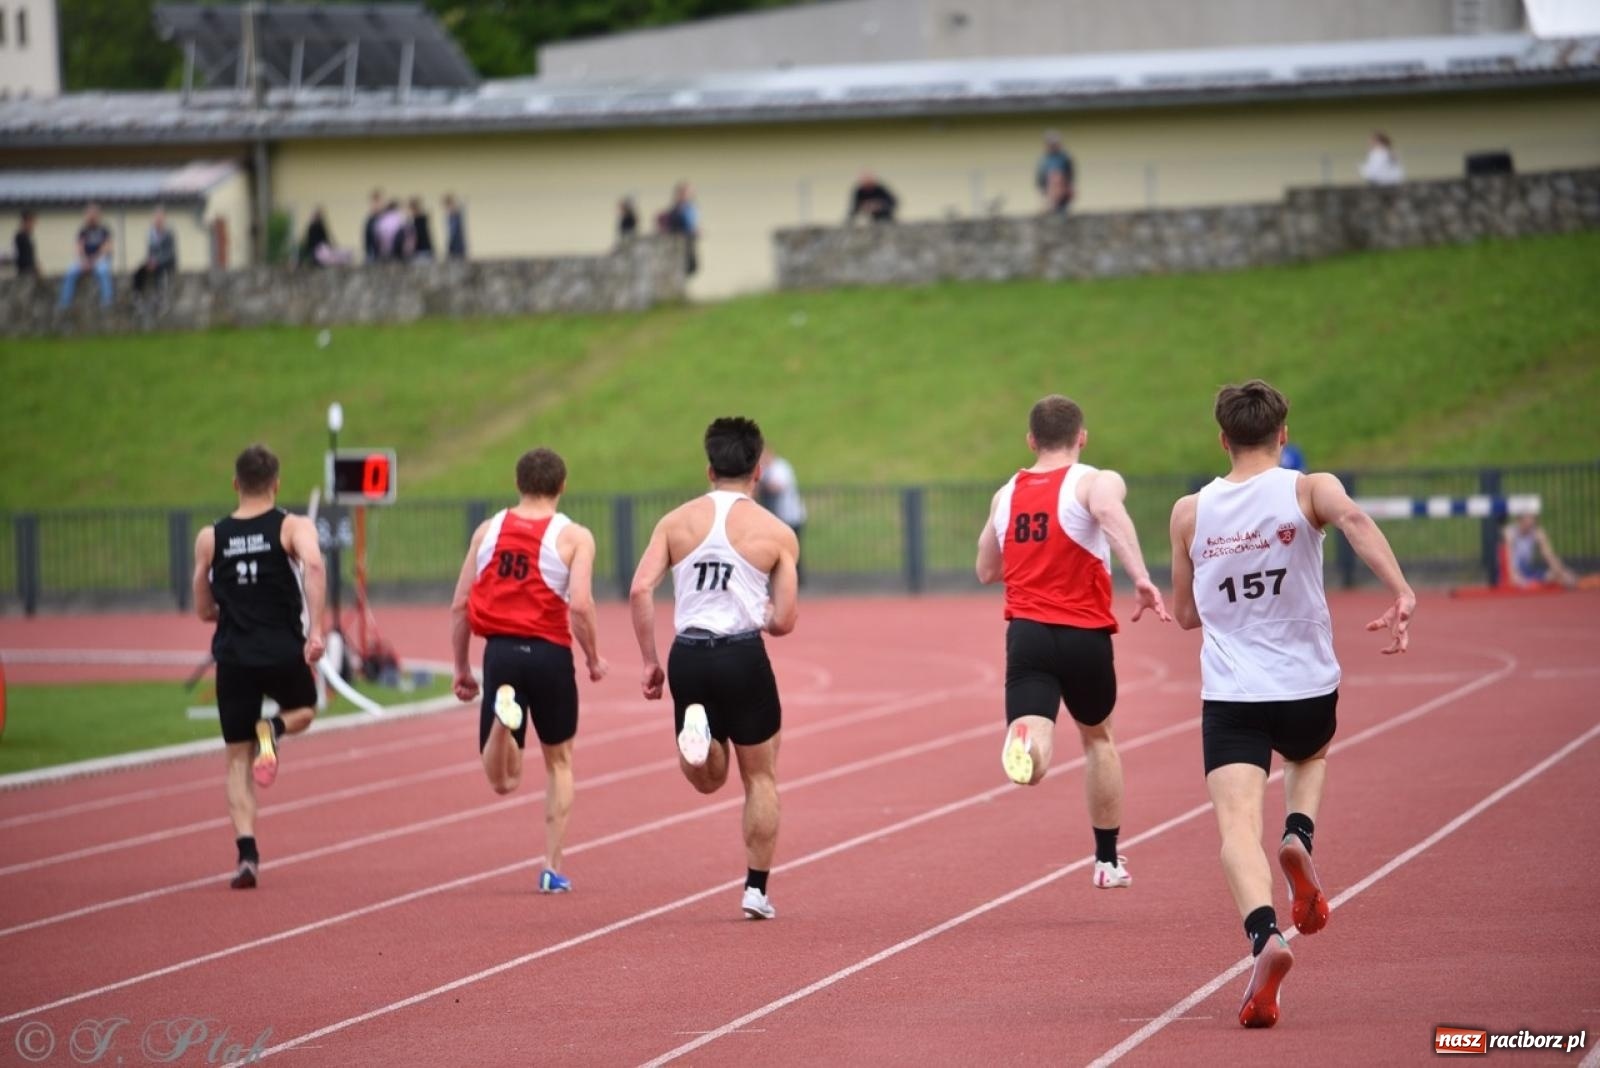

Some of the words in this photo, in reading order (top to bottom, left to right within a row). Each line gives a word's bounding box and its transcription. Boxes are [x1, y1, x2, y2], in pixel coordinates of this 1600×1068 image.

[364, 453, 389, 500] 0
[1015, 512, 1048, 543] 83
[499, 550, 528, 580] 85
[693, 561, 734, 591] 777
[1218, 568, 1287, 603] 157
